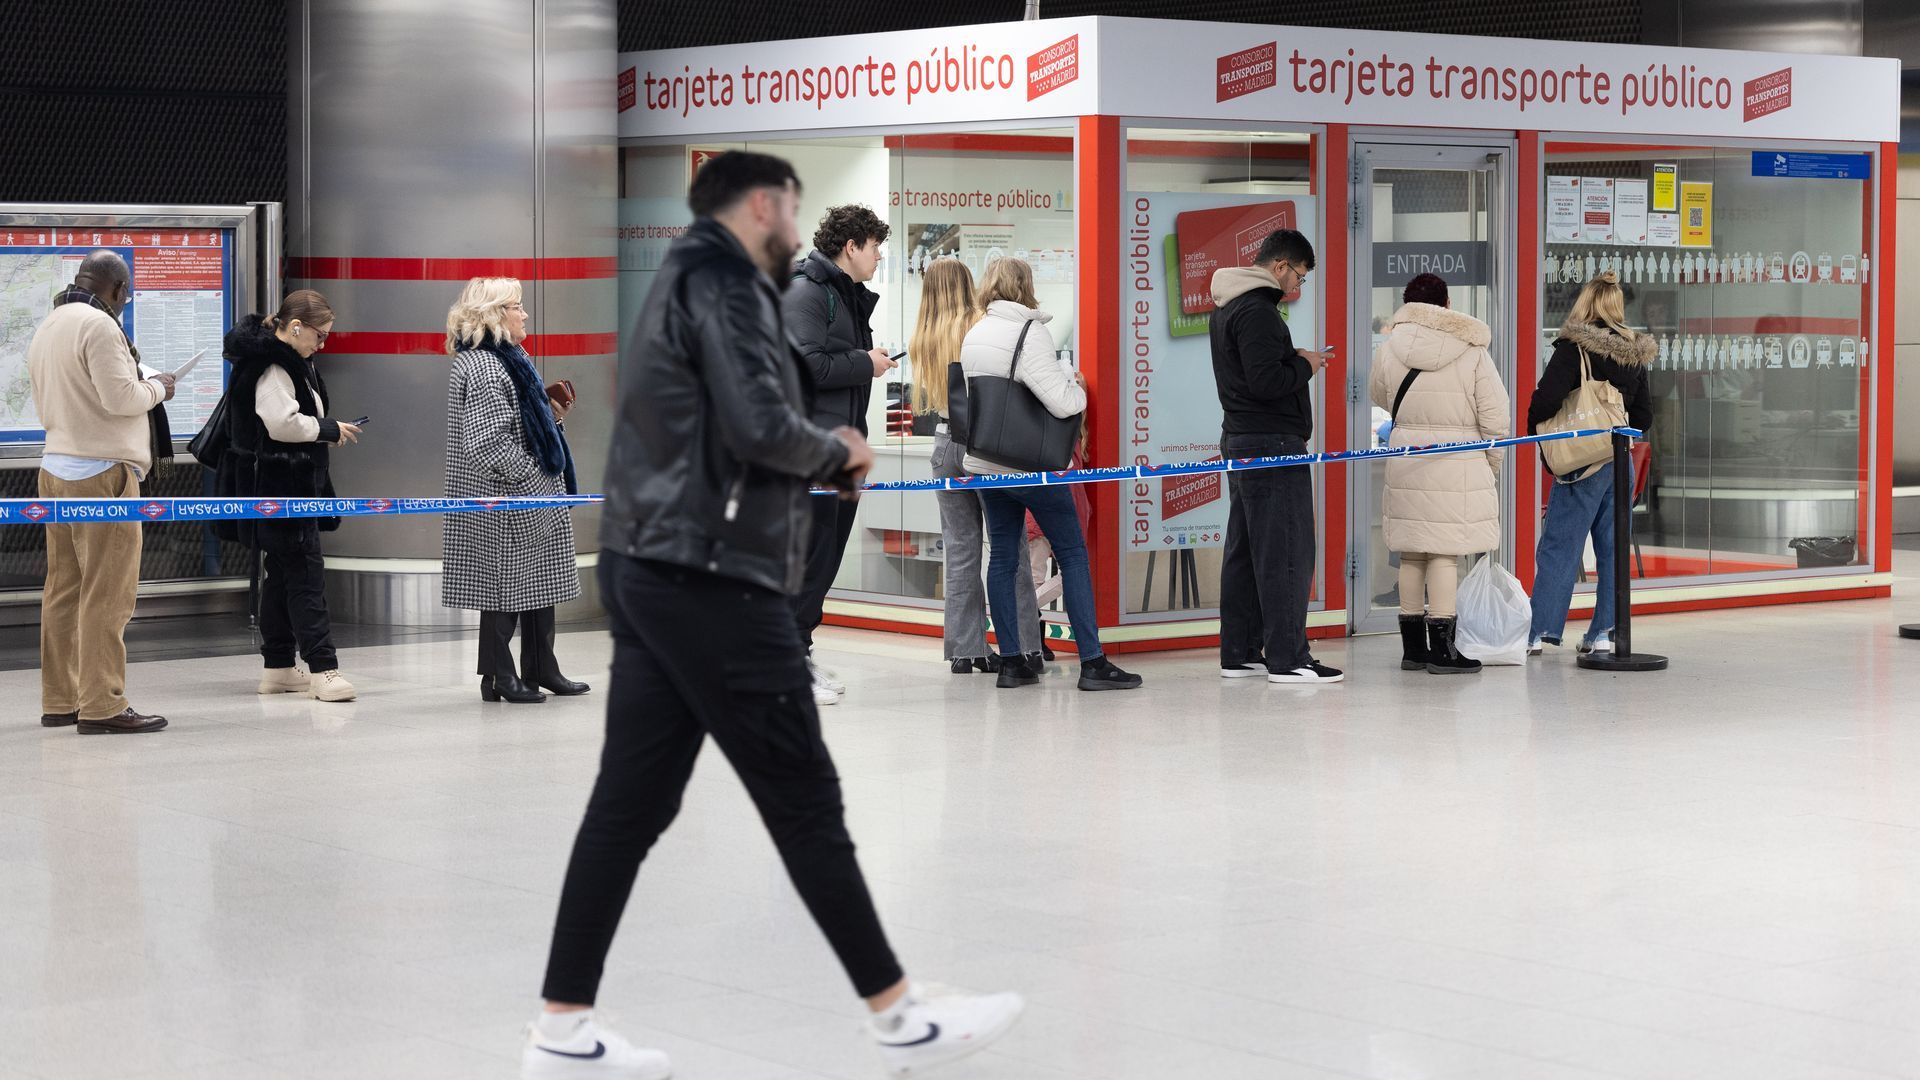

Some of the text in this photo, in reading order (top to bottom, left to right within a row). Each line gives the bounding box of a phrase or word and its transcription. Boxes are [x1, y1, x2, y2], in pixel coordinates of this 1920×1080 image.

[1039, 39, 1075, 65] CONSORCIO
[1231, 46, 1274, 67] CONSORCIO
[1030, 53, 1076, 83] TRANSPORTES
[1051, 67, 1076, 88] MADRID
[1220, 60, 1274, 85] TRANSPORTES
[644, 45, 1015, 118] tarjeta transporte público
[1244, 73, 1273, 92] MADRID
[1288, 48, 1732, 116] tarjeta transporte público
[1755, 71, 1789, 92] CONSORCIO
[1746, 84, 1789, 107] TRANSPORTES
[1766, 96, 1789, 112] MADRID
[905, 189, 993, 211] transporte
[998, 189, 1052, 212] público
[618, 224, 645, 242] arjeta
[1248, 217, 1283, 241] CONSORCIO
[1240, 235, 1268, 256] TRANSP
[1185, 252, 1205, 262] tarjeta
[1185, 258, 1217, 270] transporte
[1387, 254, 1466, 274] ENTRADA
[1185, 268, 1206, 279] público
[1130, 196, 1153, 547] tarjea transporte público
[1161, 443, 1188, 452] unimos
[1165, 473, 1218, 502] TRANSPORTES
[1189, 487, 1218, 507] MADRID
[61, 505, 128, 518] NO PASAR
[178, 503, 243, 515] NO PASAR
[292, 501, 356, 513] NO PASAR
